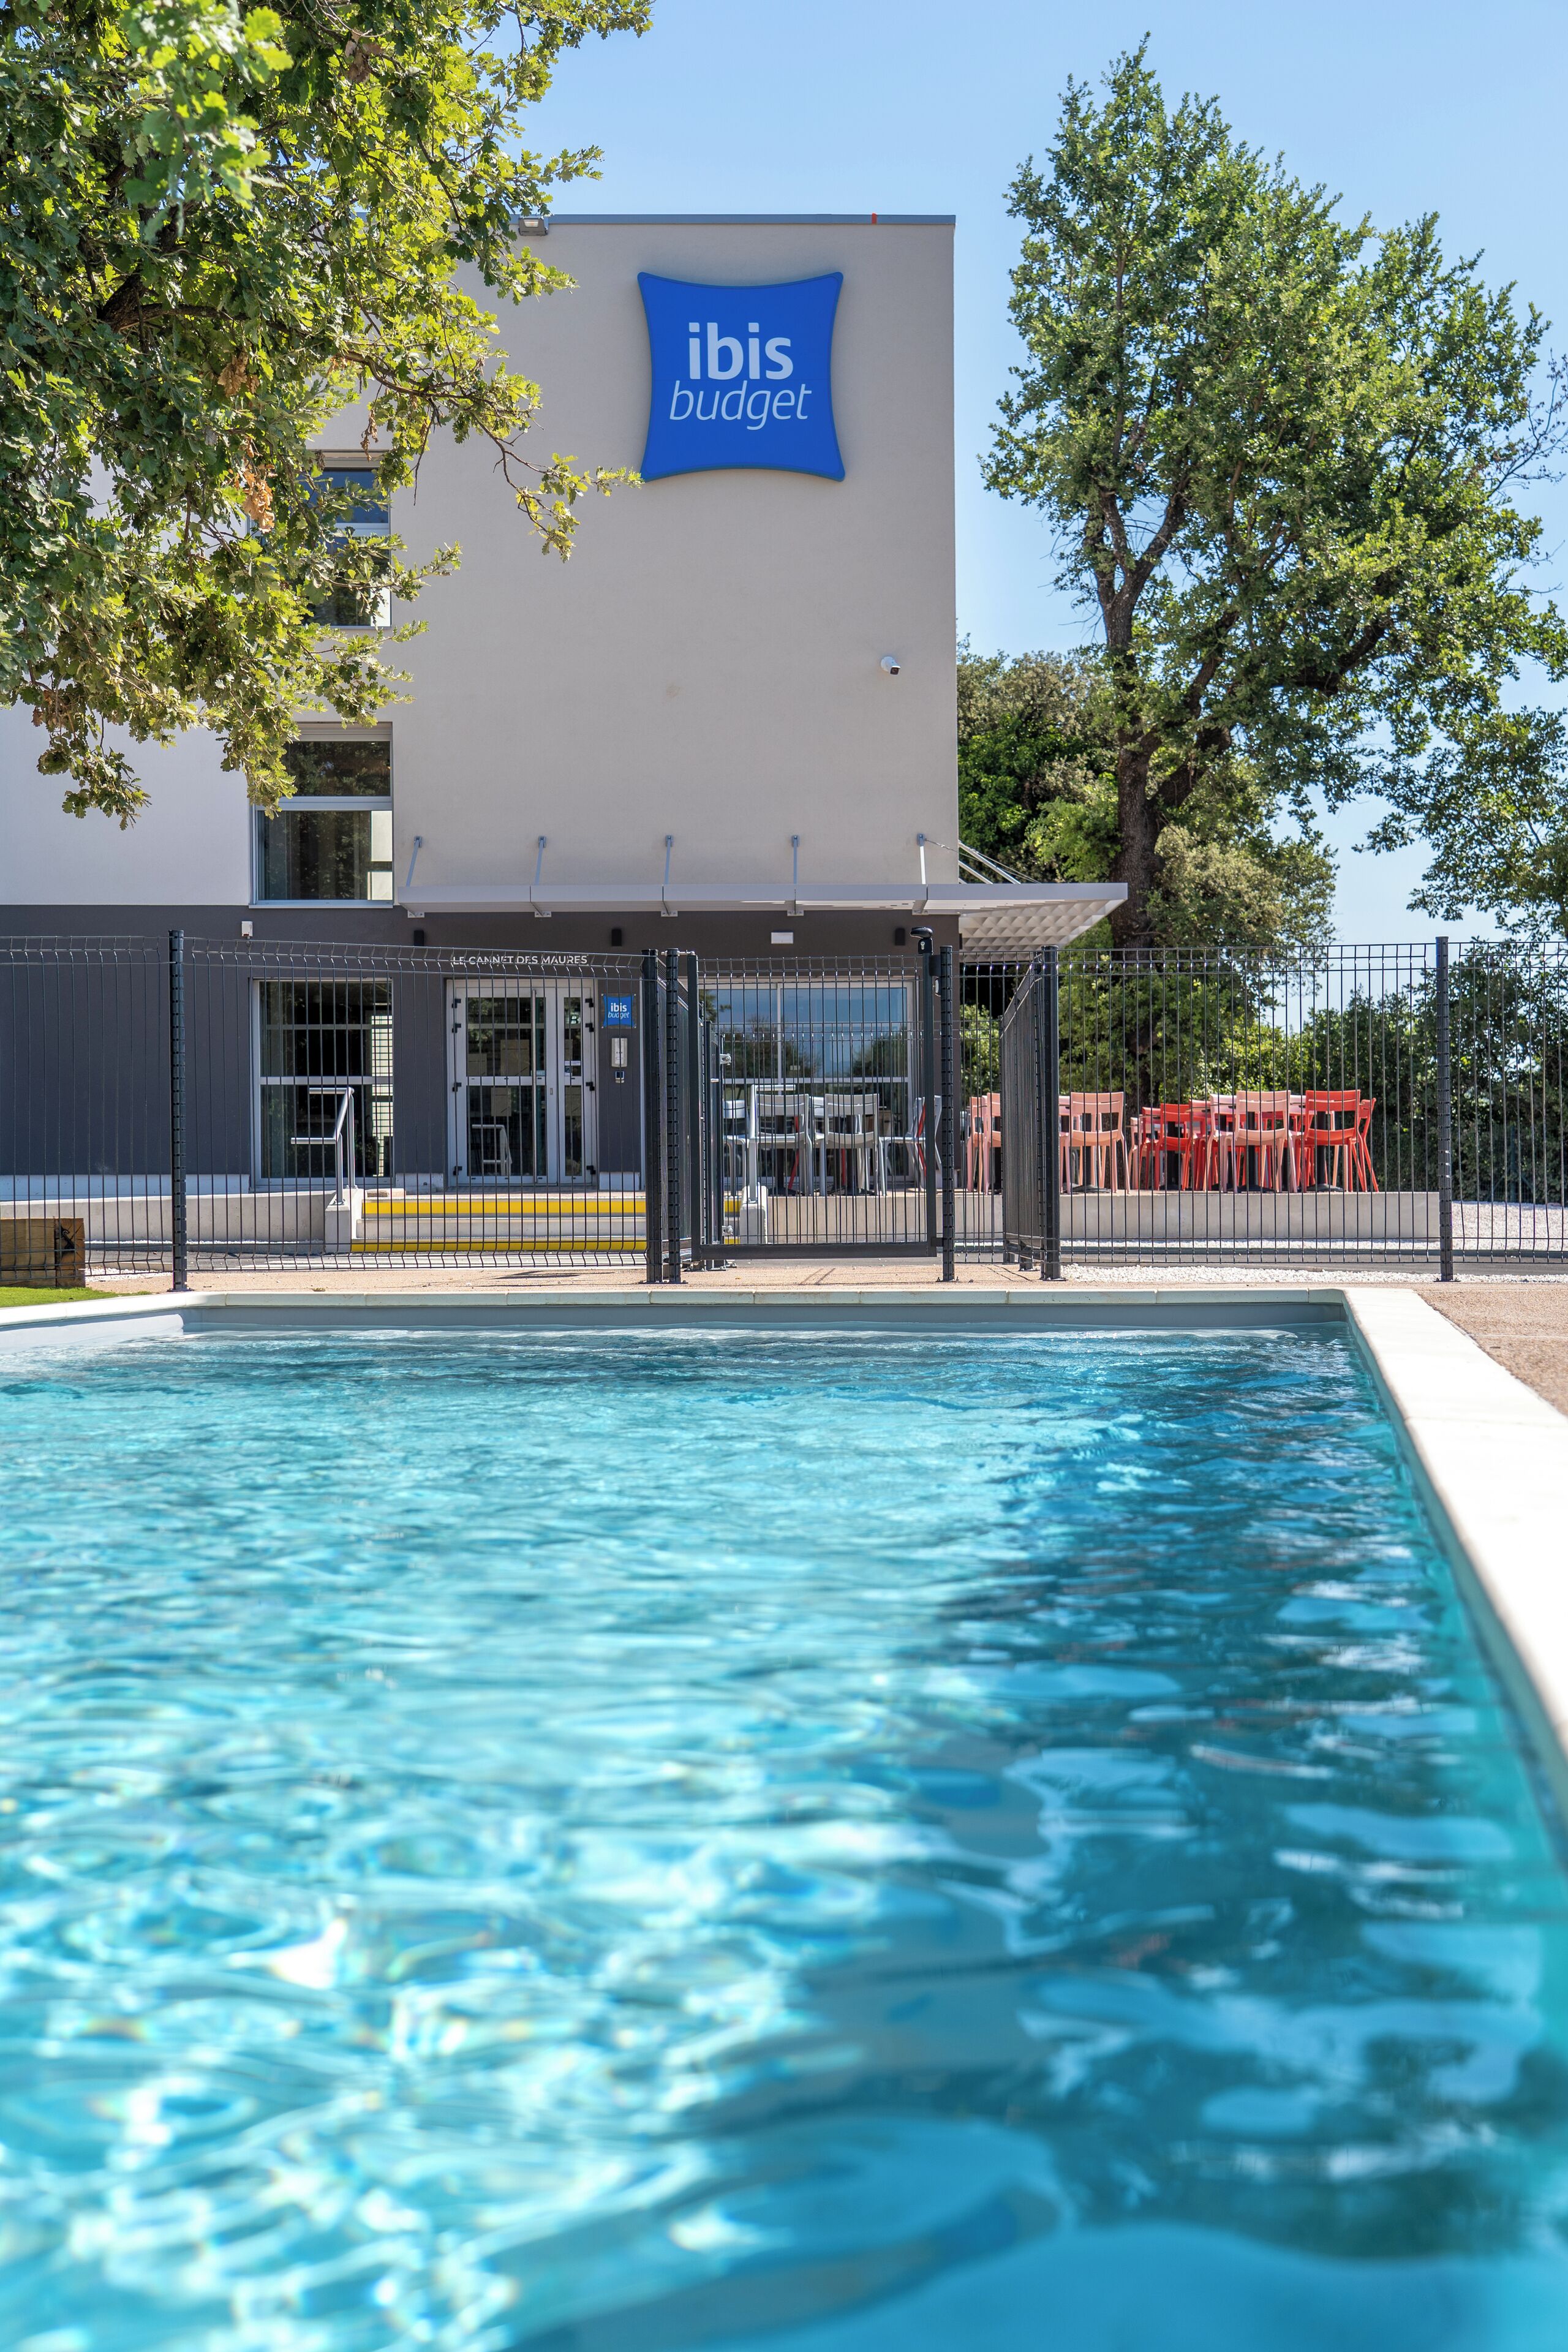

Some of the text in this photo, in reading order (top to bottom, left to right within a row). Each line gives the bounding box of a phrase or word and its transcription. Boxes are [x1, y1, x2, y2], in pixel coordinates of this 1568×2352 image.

[688, 322, 794, 380] ibis
[669, 380, 812, 431] budget
[469, 956, 514, 965] CANNET
[516, 956, 538, 964] DES
[541, 956, 588, 964] MAURES
[611, 1003, 627, 1012] ibis
[608, 1011, 630, 1020] budget
